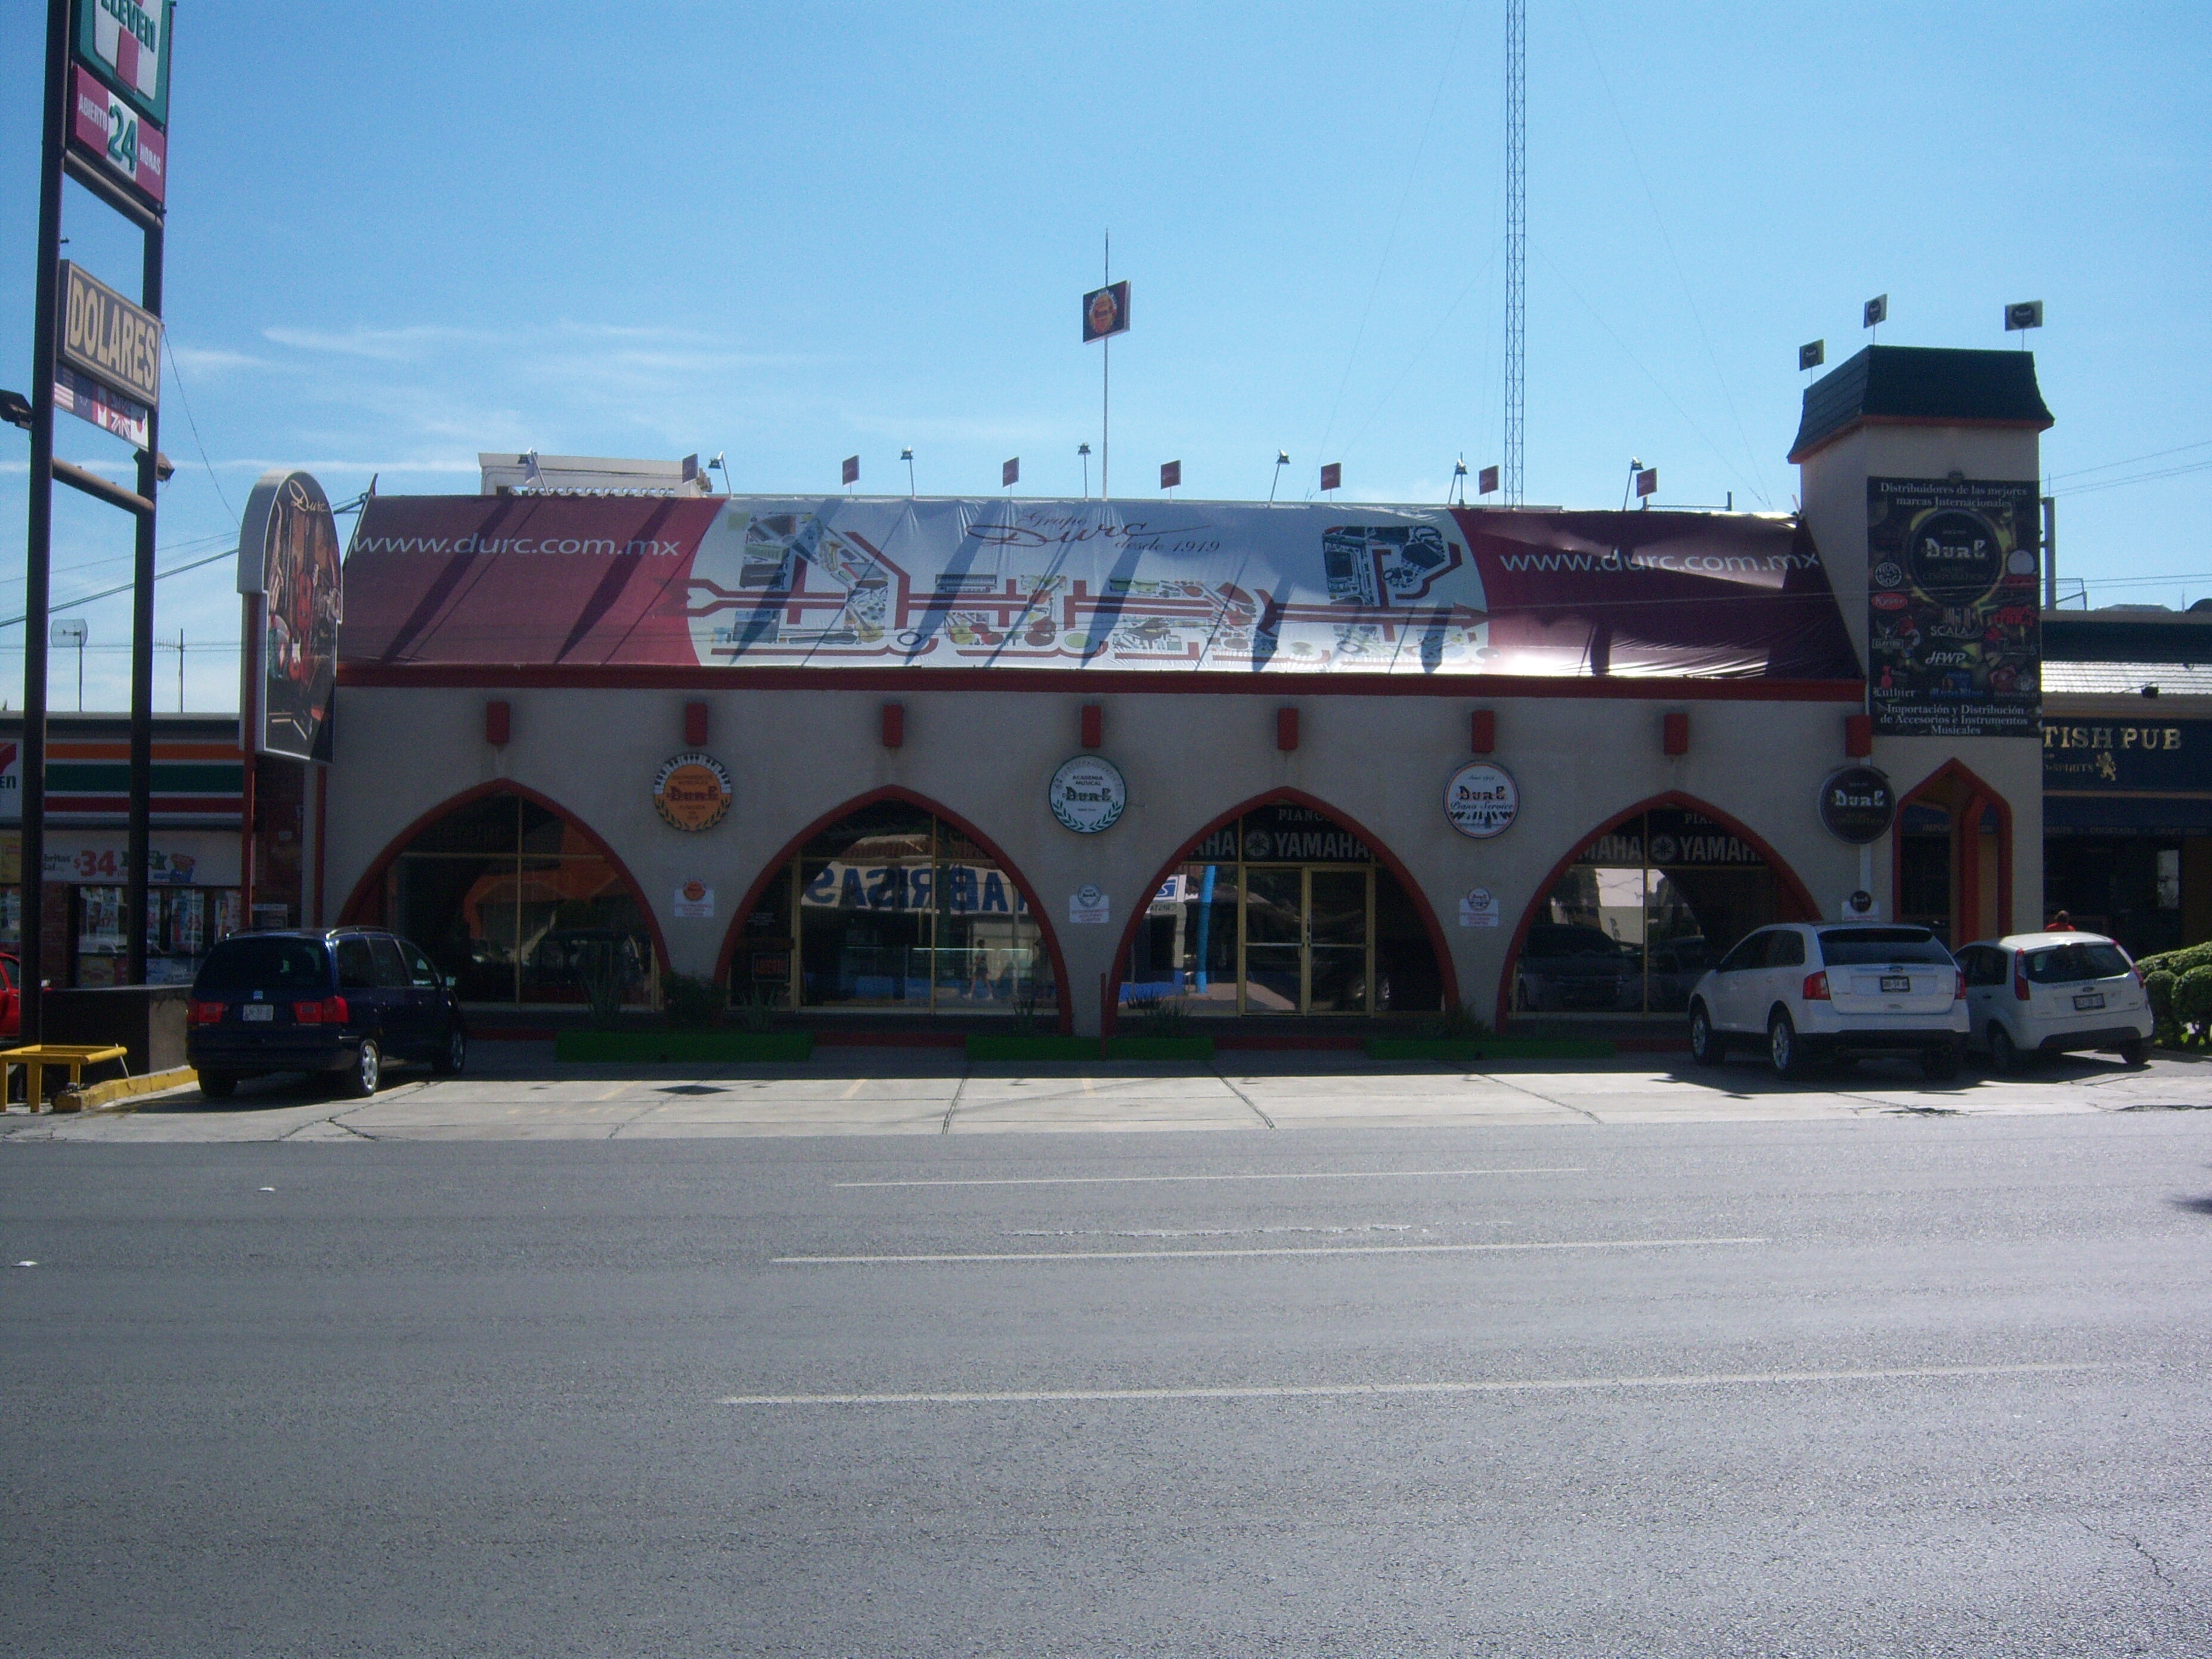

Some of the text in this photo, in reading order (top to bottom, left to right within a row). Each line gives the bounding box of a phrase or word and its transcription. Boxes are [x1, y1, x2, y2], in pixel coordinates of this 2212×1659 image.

[79, 93, 161, 175] ABIERTO 24 HORAS
[70, 277, 156, 390] DOLARES
[1880, 482, 2027, 499] Distribuidores de las mejores
[1896, 496, 2013, 508] marcas Internacionales
[354, 532, 680, 557] www.durc.com.mx
[1500, 548, 1818, 572] www.durc.com.mx
[1880, 714, 1893, 724] de
[1895, 715, 1950, 725] Accesorios
[1960, 715, 2028, 725] Instrumentos
[1886, 703, 1950, 715] Importación
[1961, 704, 2025, 715] Distribución
[1931, 725, 1981, 735] Musicales
[2120, 728, 2182, 749] PUB
[1278, 808, 1324, 821] PIANO
[1274, 832, 1370, 858] YAMAHA
[1679, 836, 1755, 861] YAMAH
